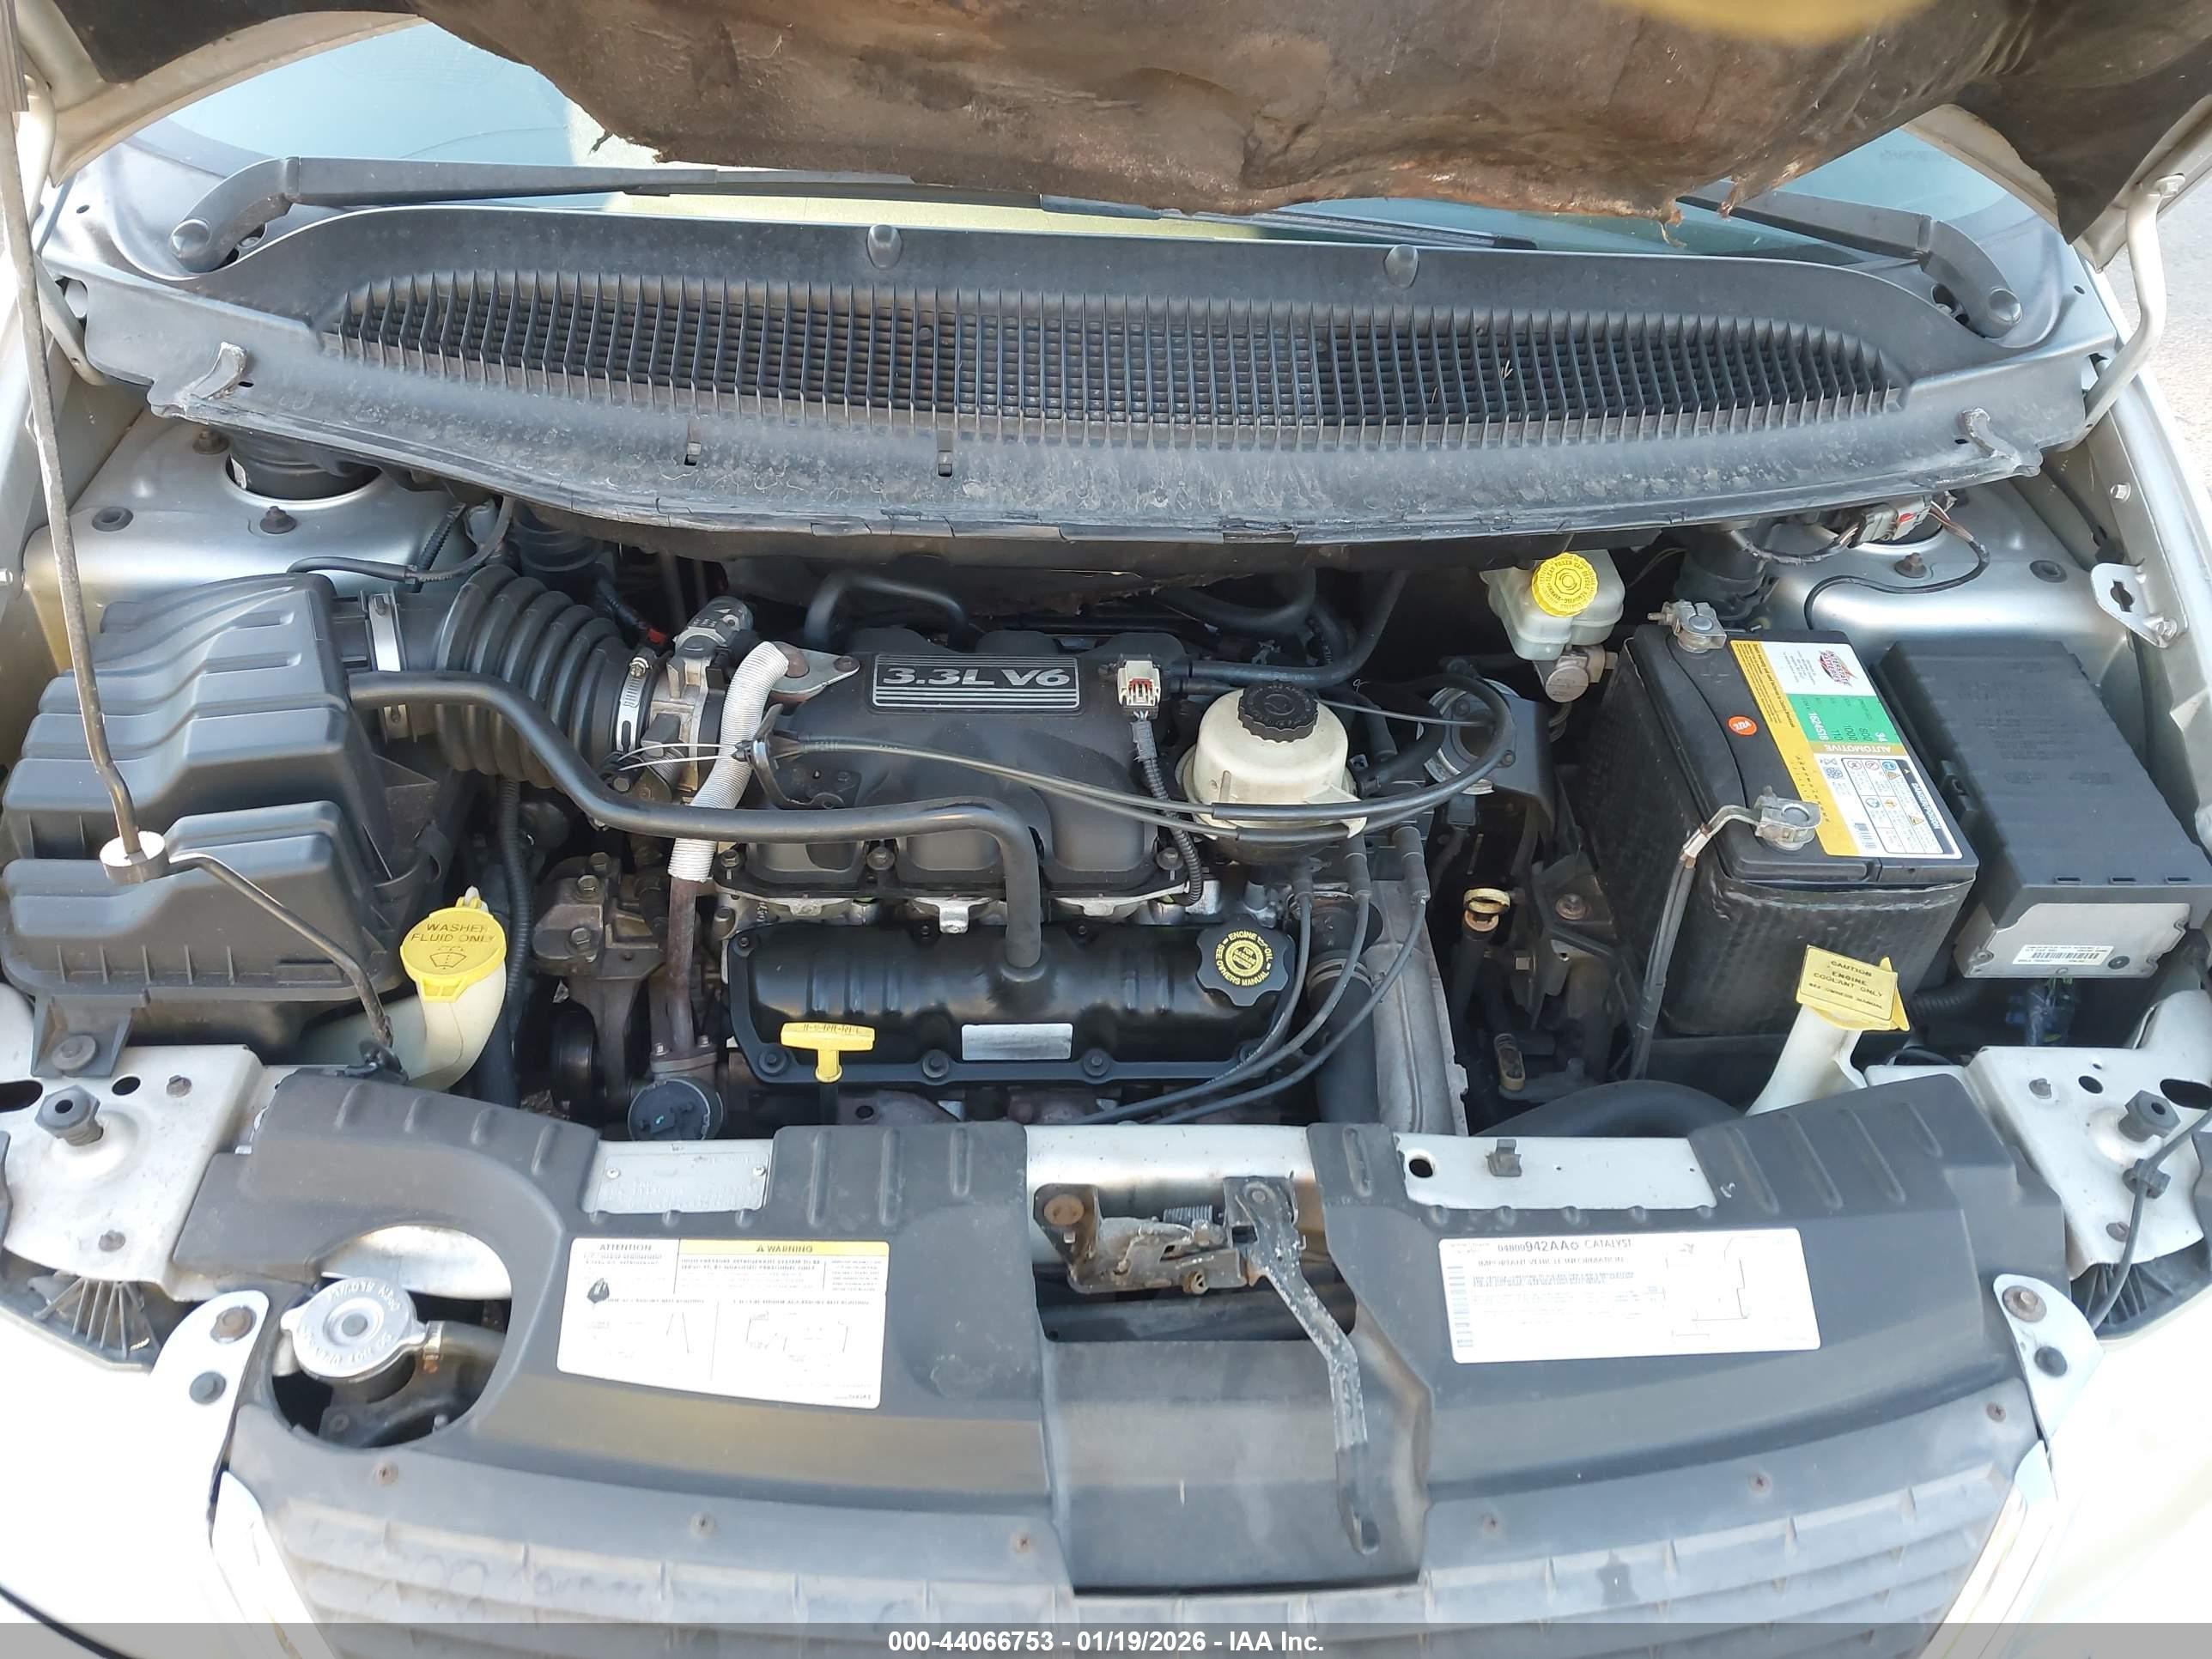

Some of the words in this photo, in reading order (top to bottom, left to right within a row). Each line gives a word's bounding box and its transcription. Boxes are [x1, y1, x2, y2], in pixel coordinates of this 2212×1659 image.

[883, 667, 995, 686] 3.3L
[1001, 668, 1070, 687] V6
[1829, 728, 1844, 740] 110
[1841, 724, 1859, 741] 1000
[1857, 727, 1873, 741] 800
[1825, 744, 1891, 753] AUTOMOTIVE
[427, 924, 489, 933] WASHER
[410, 933, 453, 942] FLUID
[1215, 943, 1225, 960] SEE
[1228, 930, 1257, 941] ENGINE
[1264, 948, 1273, 962] OIL
[1216, 960, 1241, 986] OWNERS
[1831, 961, 1872, 977] CAUTION
[1242, 971, 1270, 986] MANUAL
[1814, 972, 1855, 988] COOLANT
[1860, 987, 1883, 997] ONLY
[1832, 971, 1868, 986] ENGINE
[1584, 1239, 1632, 1249] CATALYST
